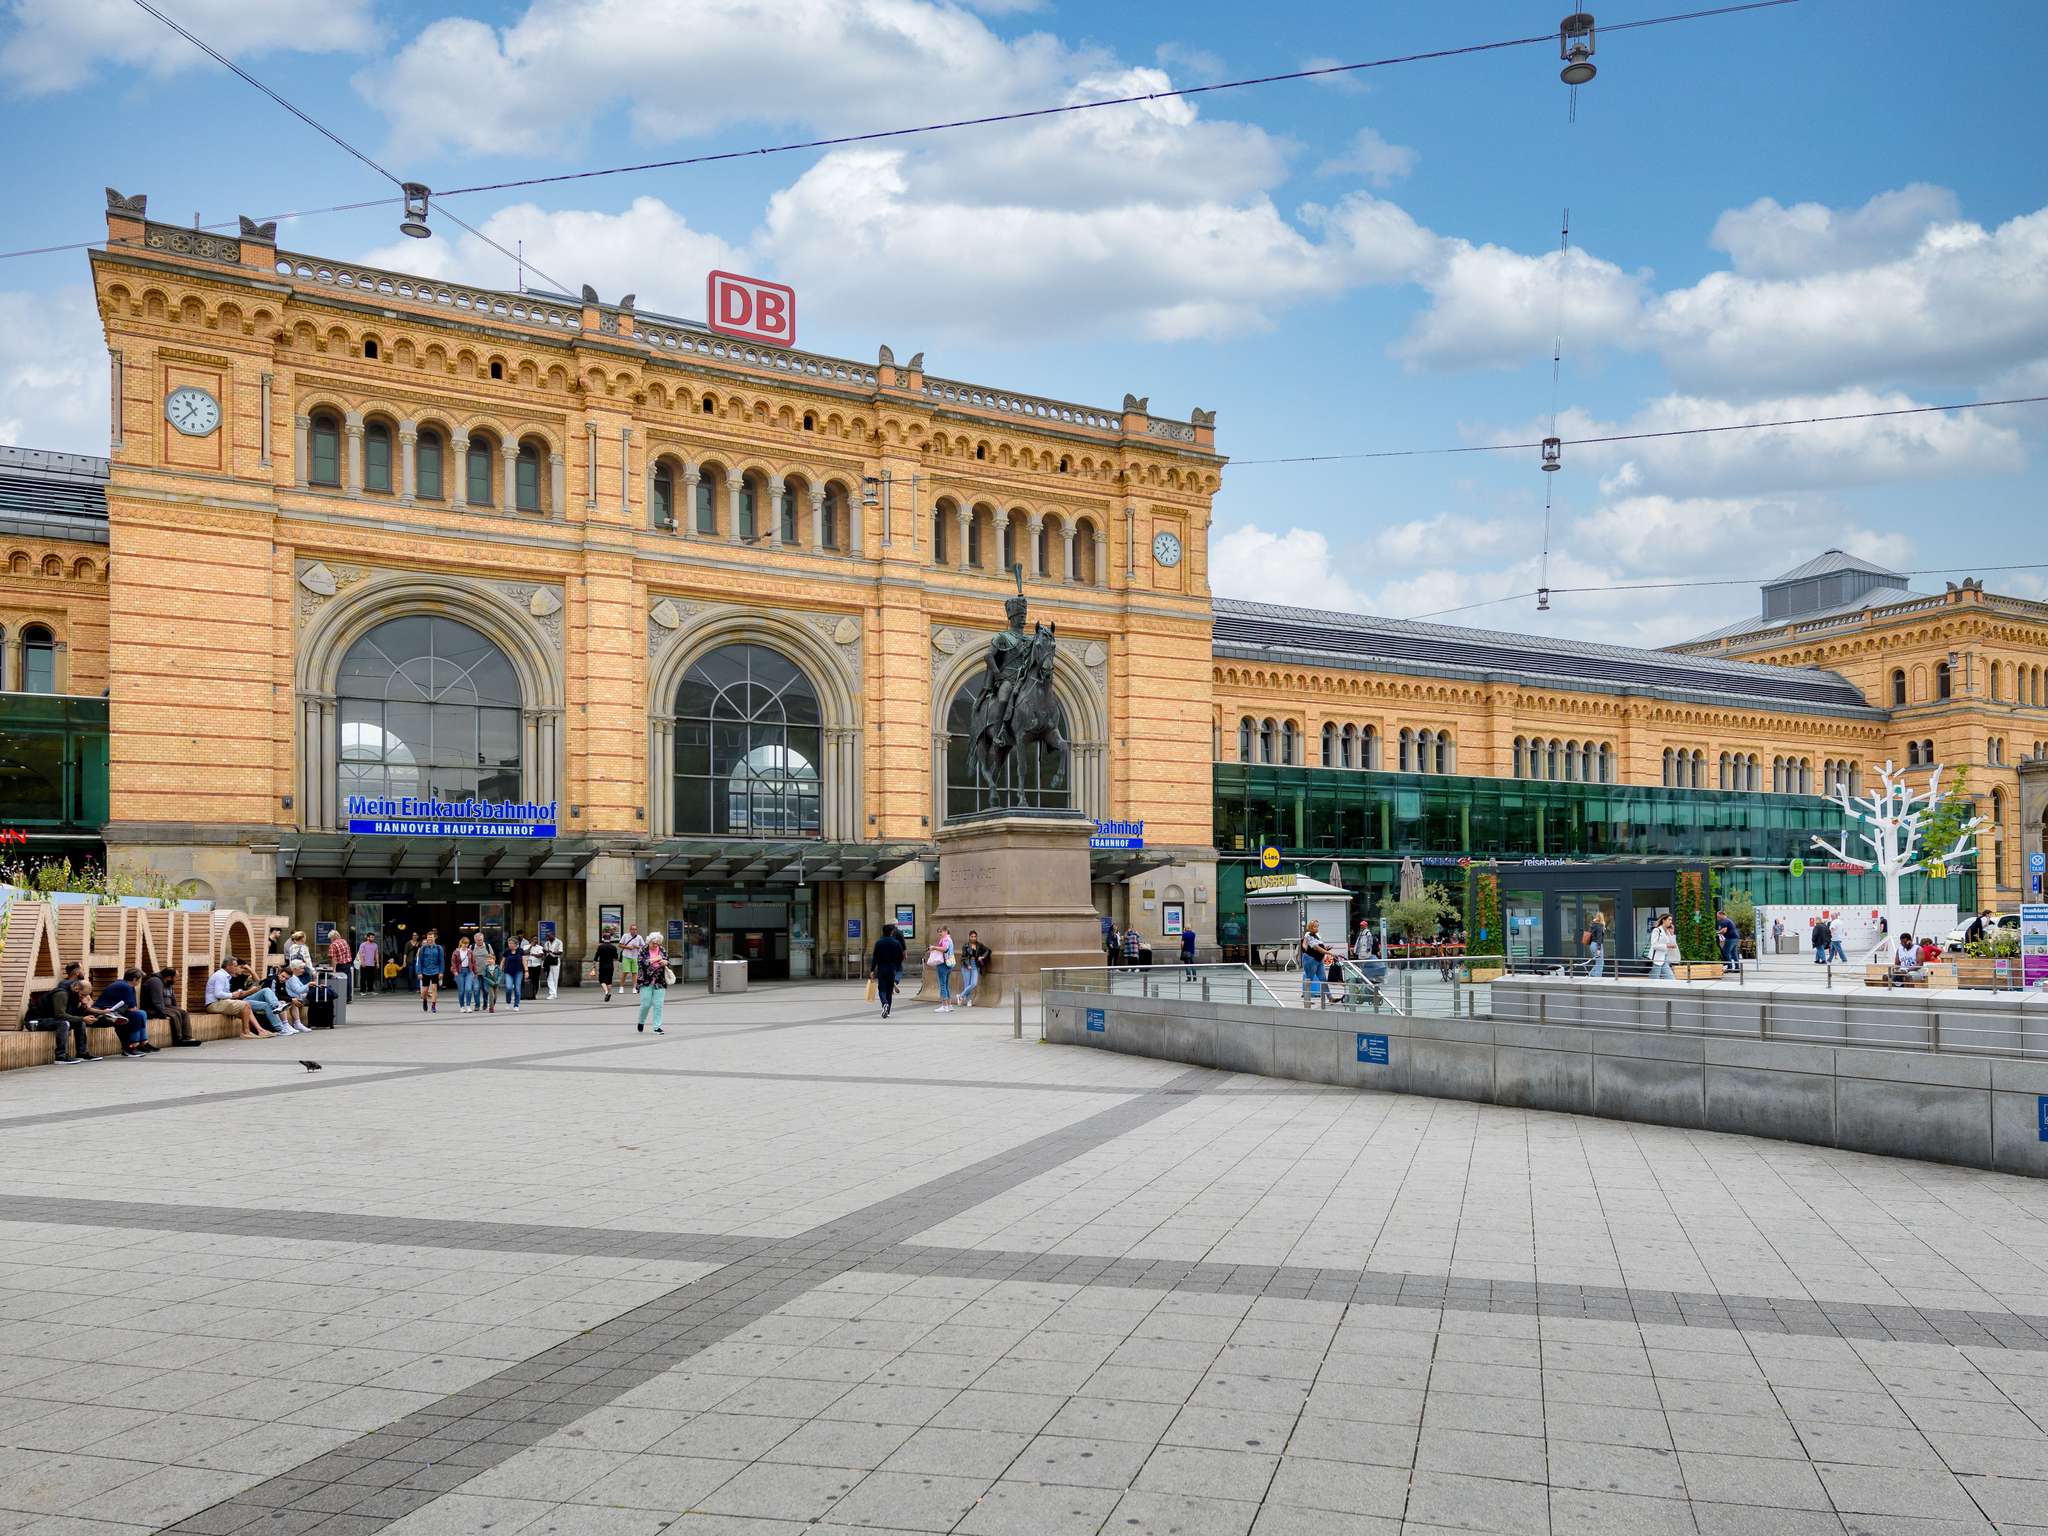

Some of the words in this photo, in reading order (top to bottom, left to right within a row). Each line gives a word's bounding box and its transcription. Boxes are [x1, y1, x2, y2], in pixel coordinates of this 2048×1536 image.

[720, 281, 787, 333] DB
[348, 795, 396, 816] Mein
[401, 797, 557, 820] Einkaufsbahnhof
[375, 822, 439, 834] HANNOVER
[443, 824, 535, 836] HAUPTBAHNHOF
[1523, 856, 1566, 866] reisebank
[1245, 874, 1297, 889] COLOSSEUM
